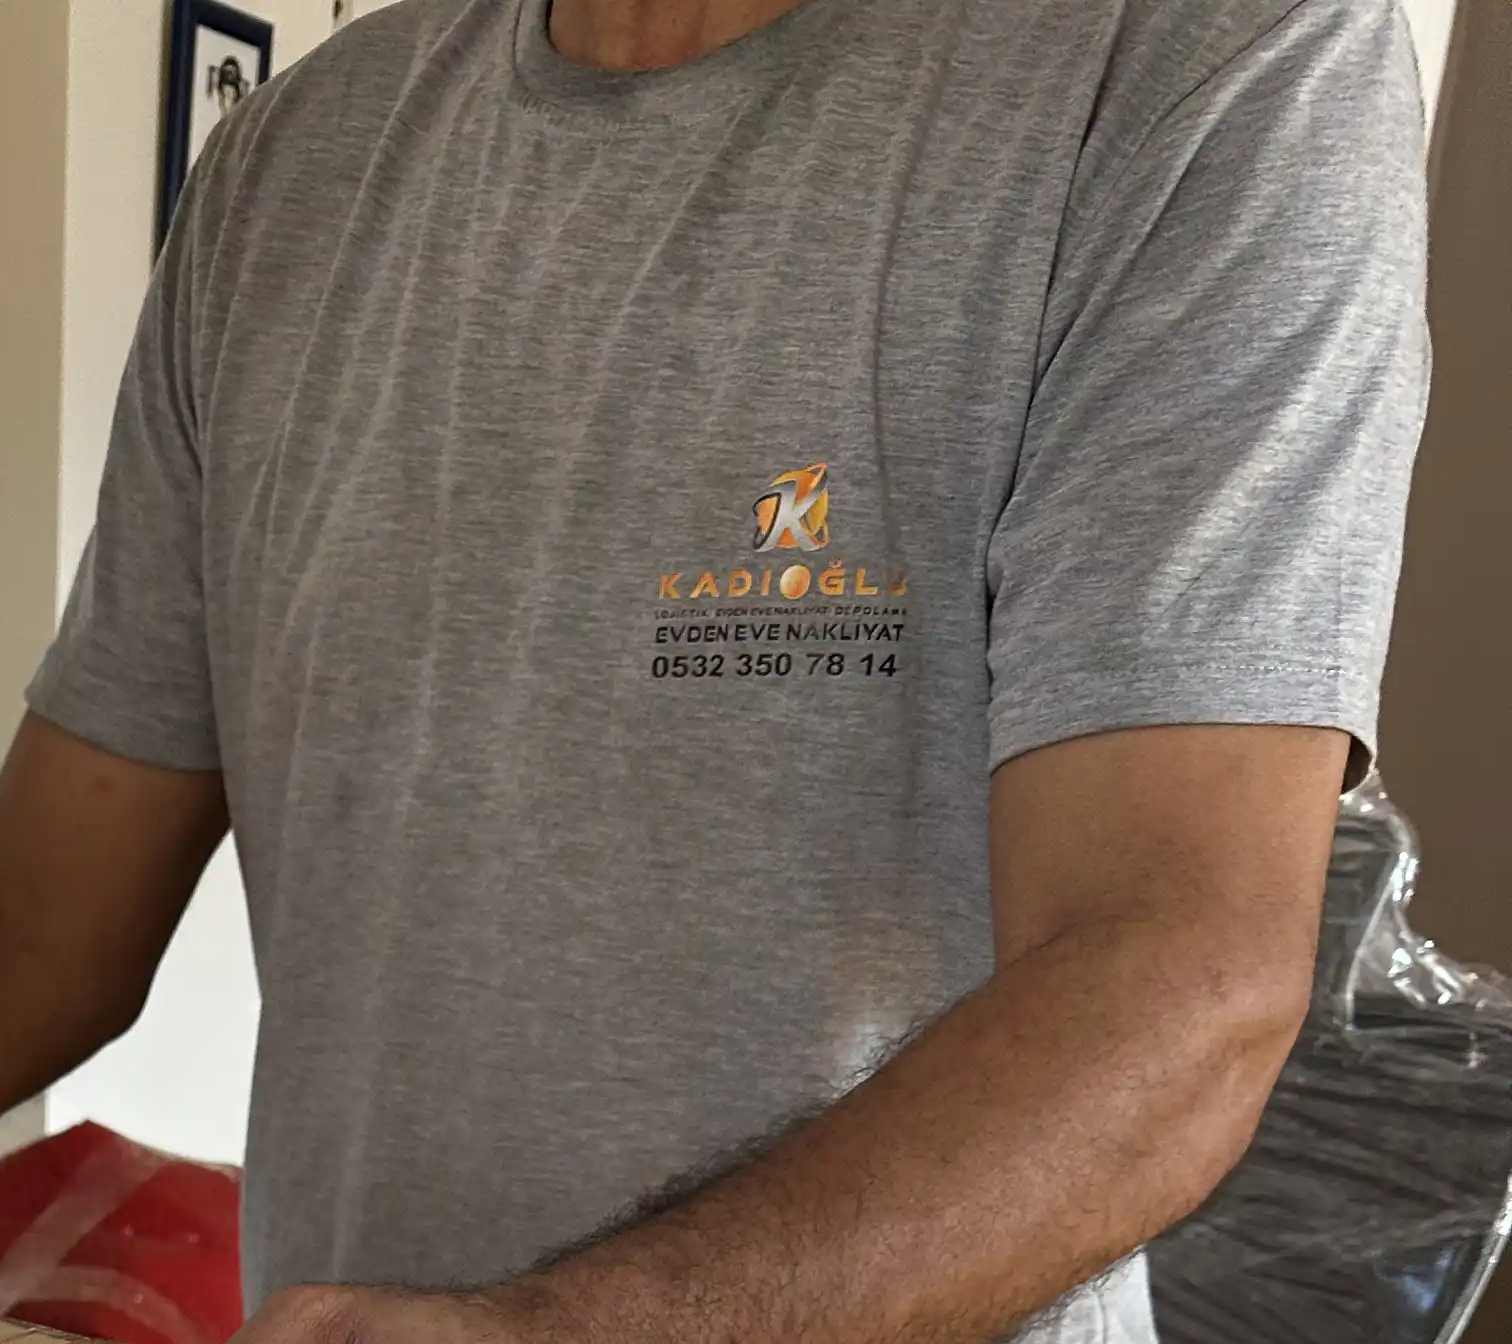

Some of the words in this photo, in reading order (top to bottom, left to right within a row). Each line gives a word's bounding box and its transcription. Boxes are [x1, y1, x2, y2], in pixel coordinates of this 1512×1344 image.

[655, 626, 728, 644] EVDEN
[734, 624, 781, 642] EVE
[652, 654, 725, 678] 0532
[737, 653, 792, 677] 350
[806, 653, 845, 676] 78
[859, 653, 898, 677] 14
